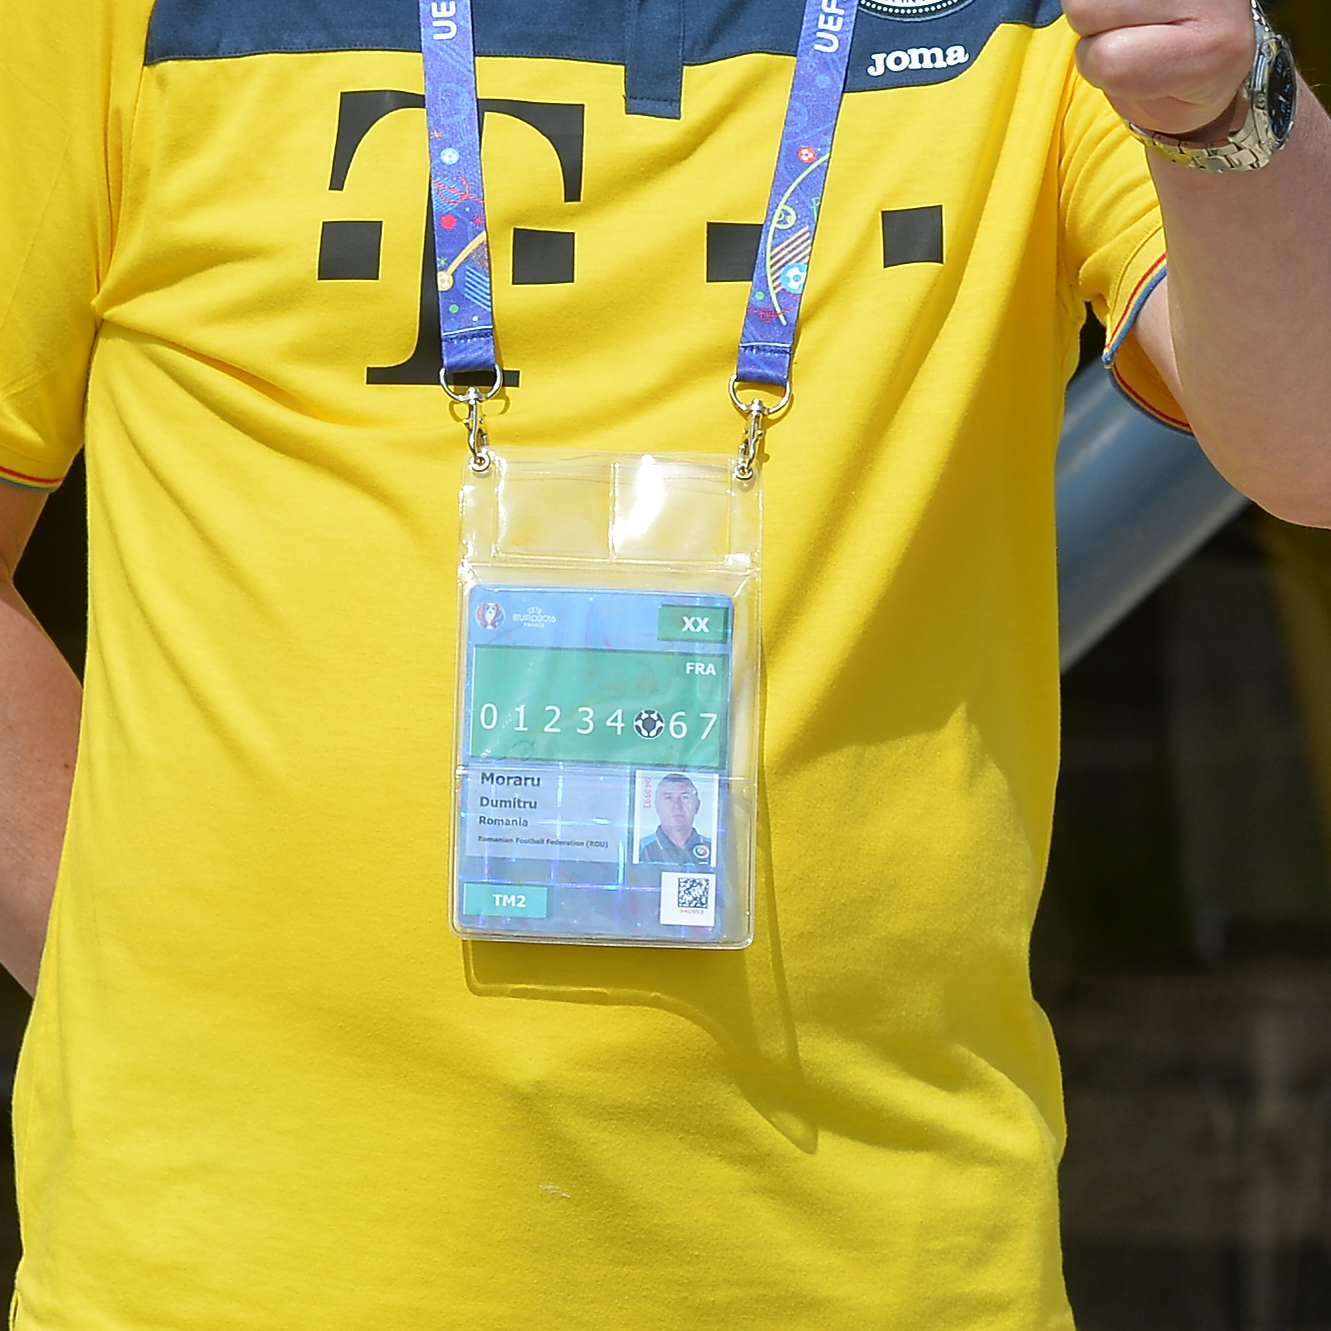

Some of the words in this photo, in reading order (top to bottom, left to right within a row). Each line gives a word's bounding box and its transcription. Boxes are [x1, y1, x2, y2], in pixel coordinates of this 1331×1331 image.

[682, 616, 710, 633] XX
[685, 662, 717, 676] FRA
[480, 703, 498, 730] 0
[514, 704, 528, 732] 1
[543, 705, 562, 733] 2
[576, 707, 595, 735] 3
[605, 708, 625, 736] 4
[669, 711, 688, 739] 6
[699, 713, 718, 740] 7
[481, 772, 541, 787] Moraru
[480, 796, 537, 809] Dumitru
[478, 815, 529, 827] Romania
[492, 893, 527, 908] TM2
